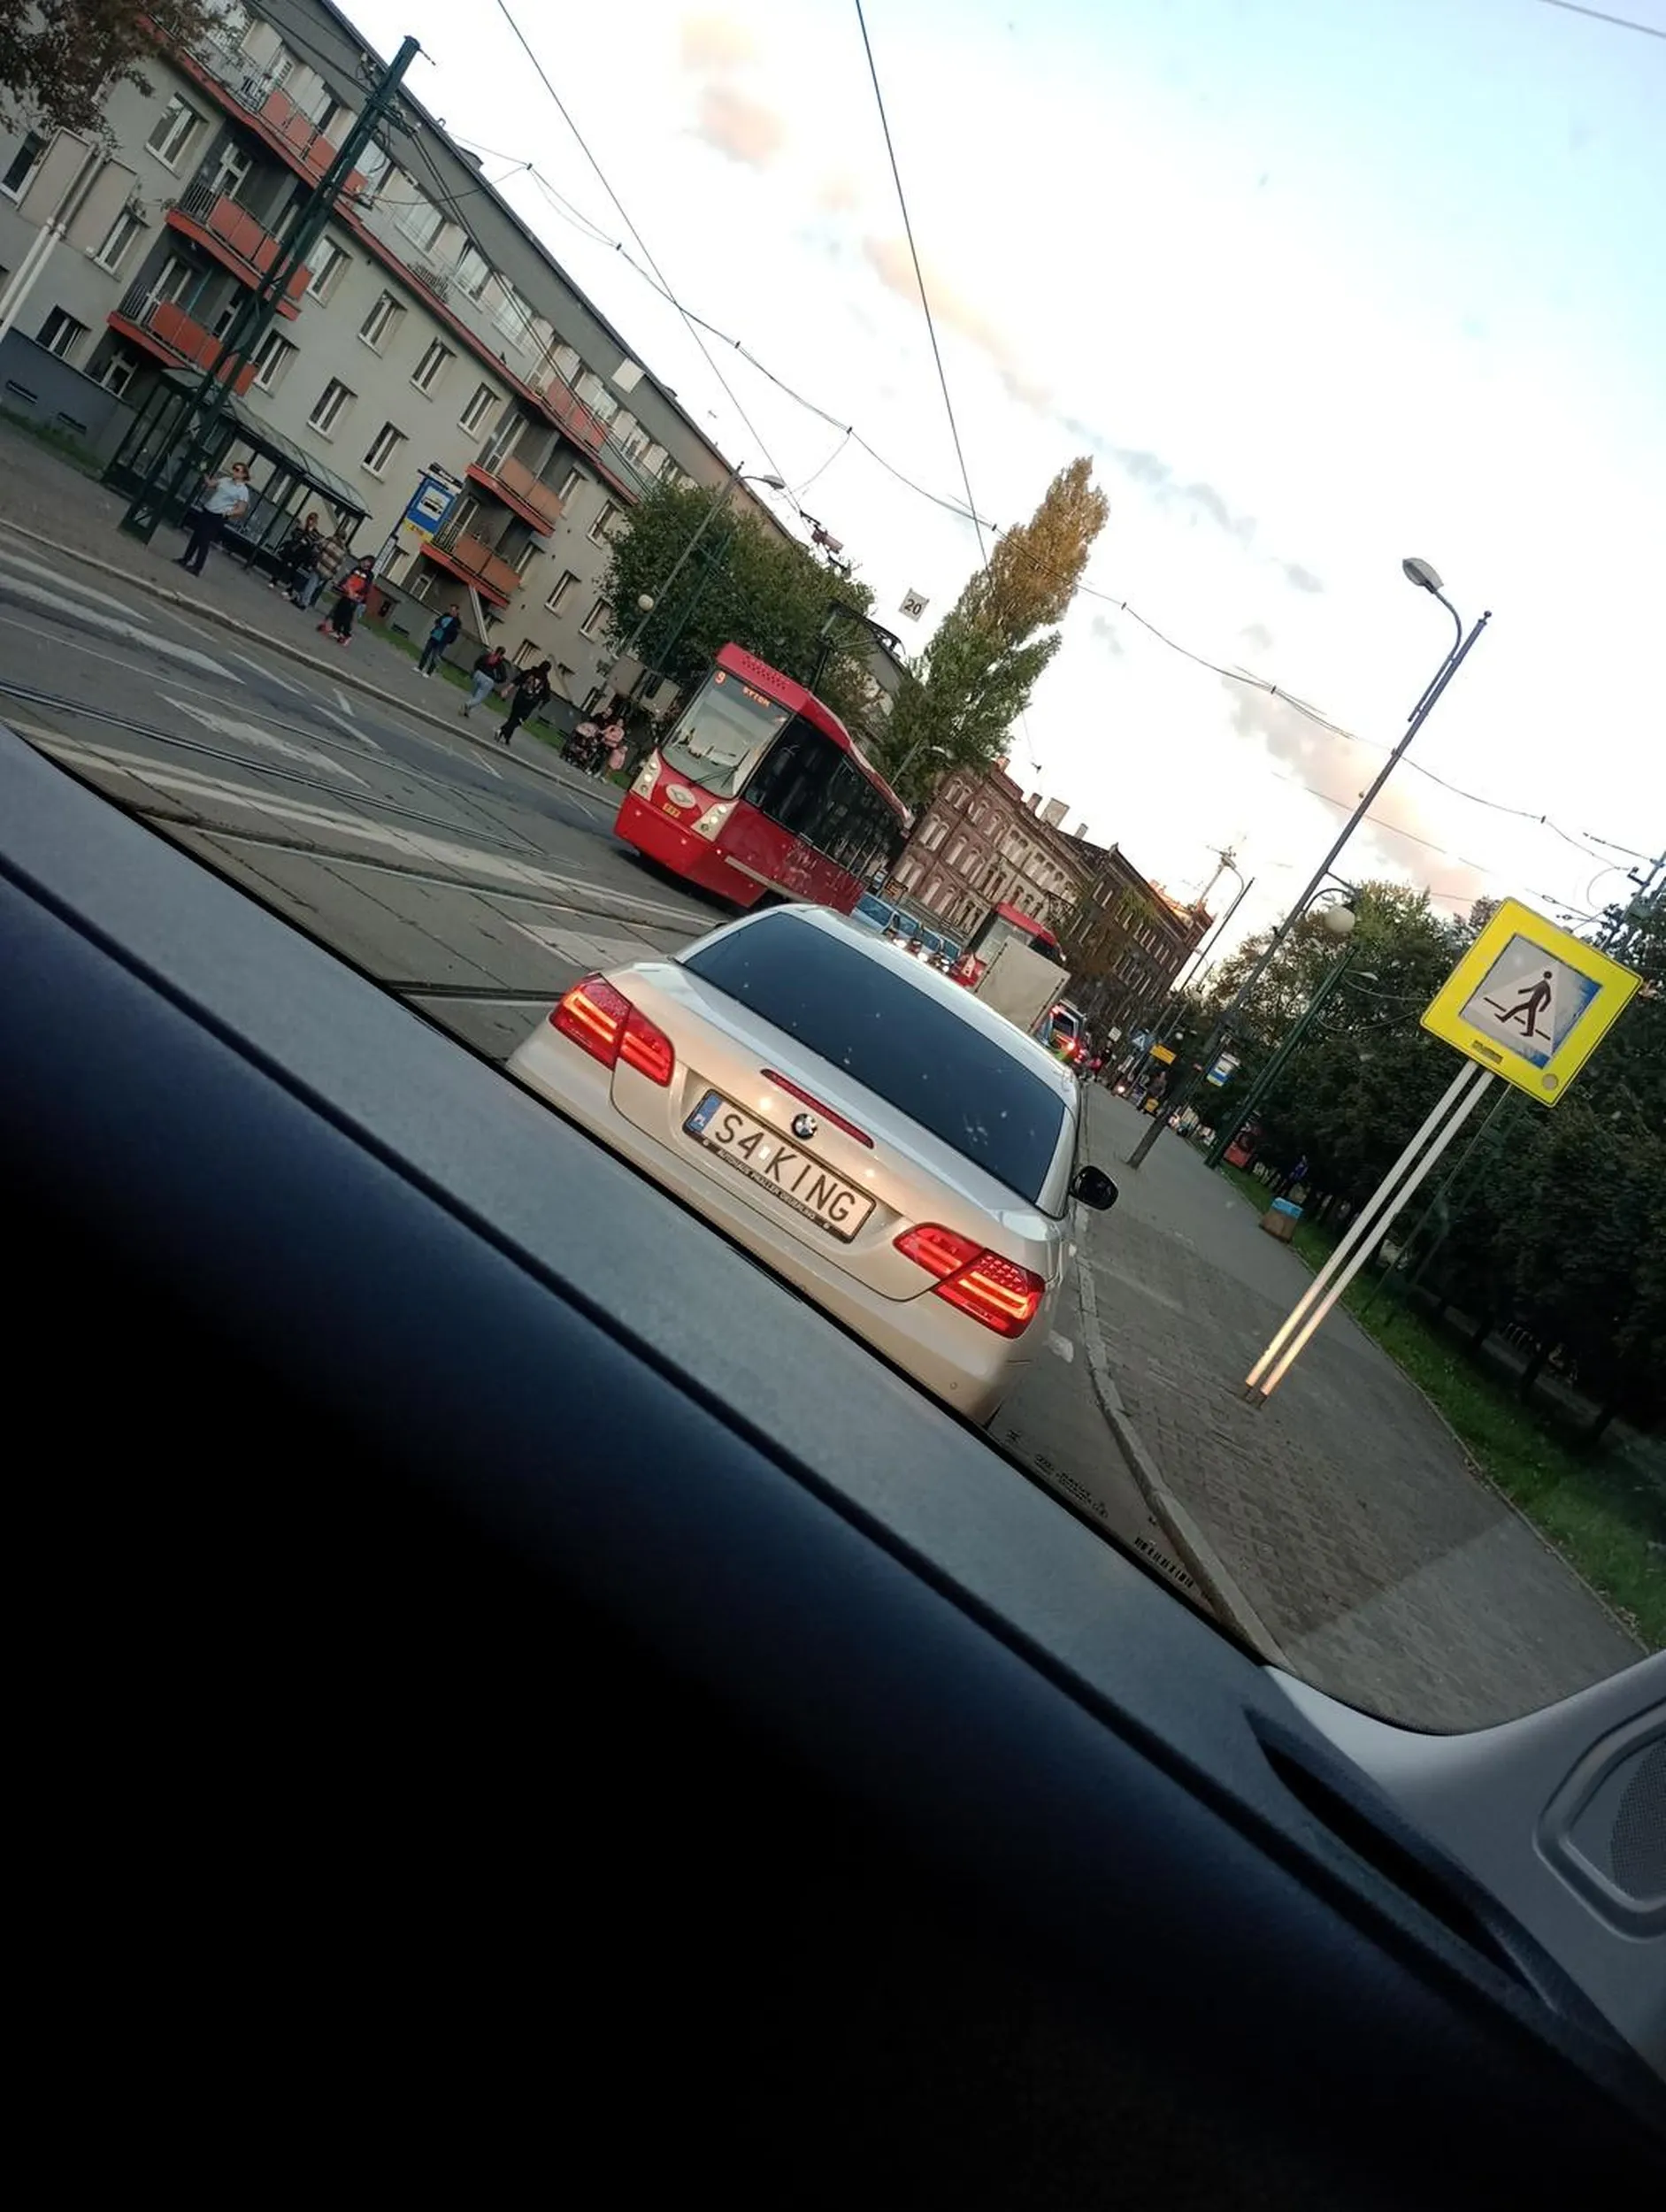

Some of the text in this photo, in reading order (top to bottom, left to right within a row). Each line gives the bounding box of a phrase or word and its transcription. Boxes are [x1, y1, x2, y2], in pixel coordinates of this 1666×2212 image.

[904, 598, 922, 615] 20
[715, 671, 726, 684] 9
[715, 1113, 764, 1160] S4
[764, 1146, 856, 1223] KING
